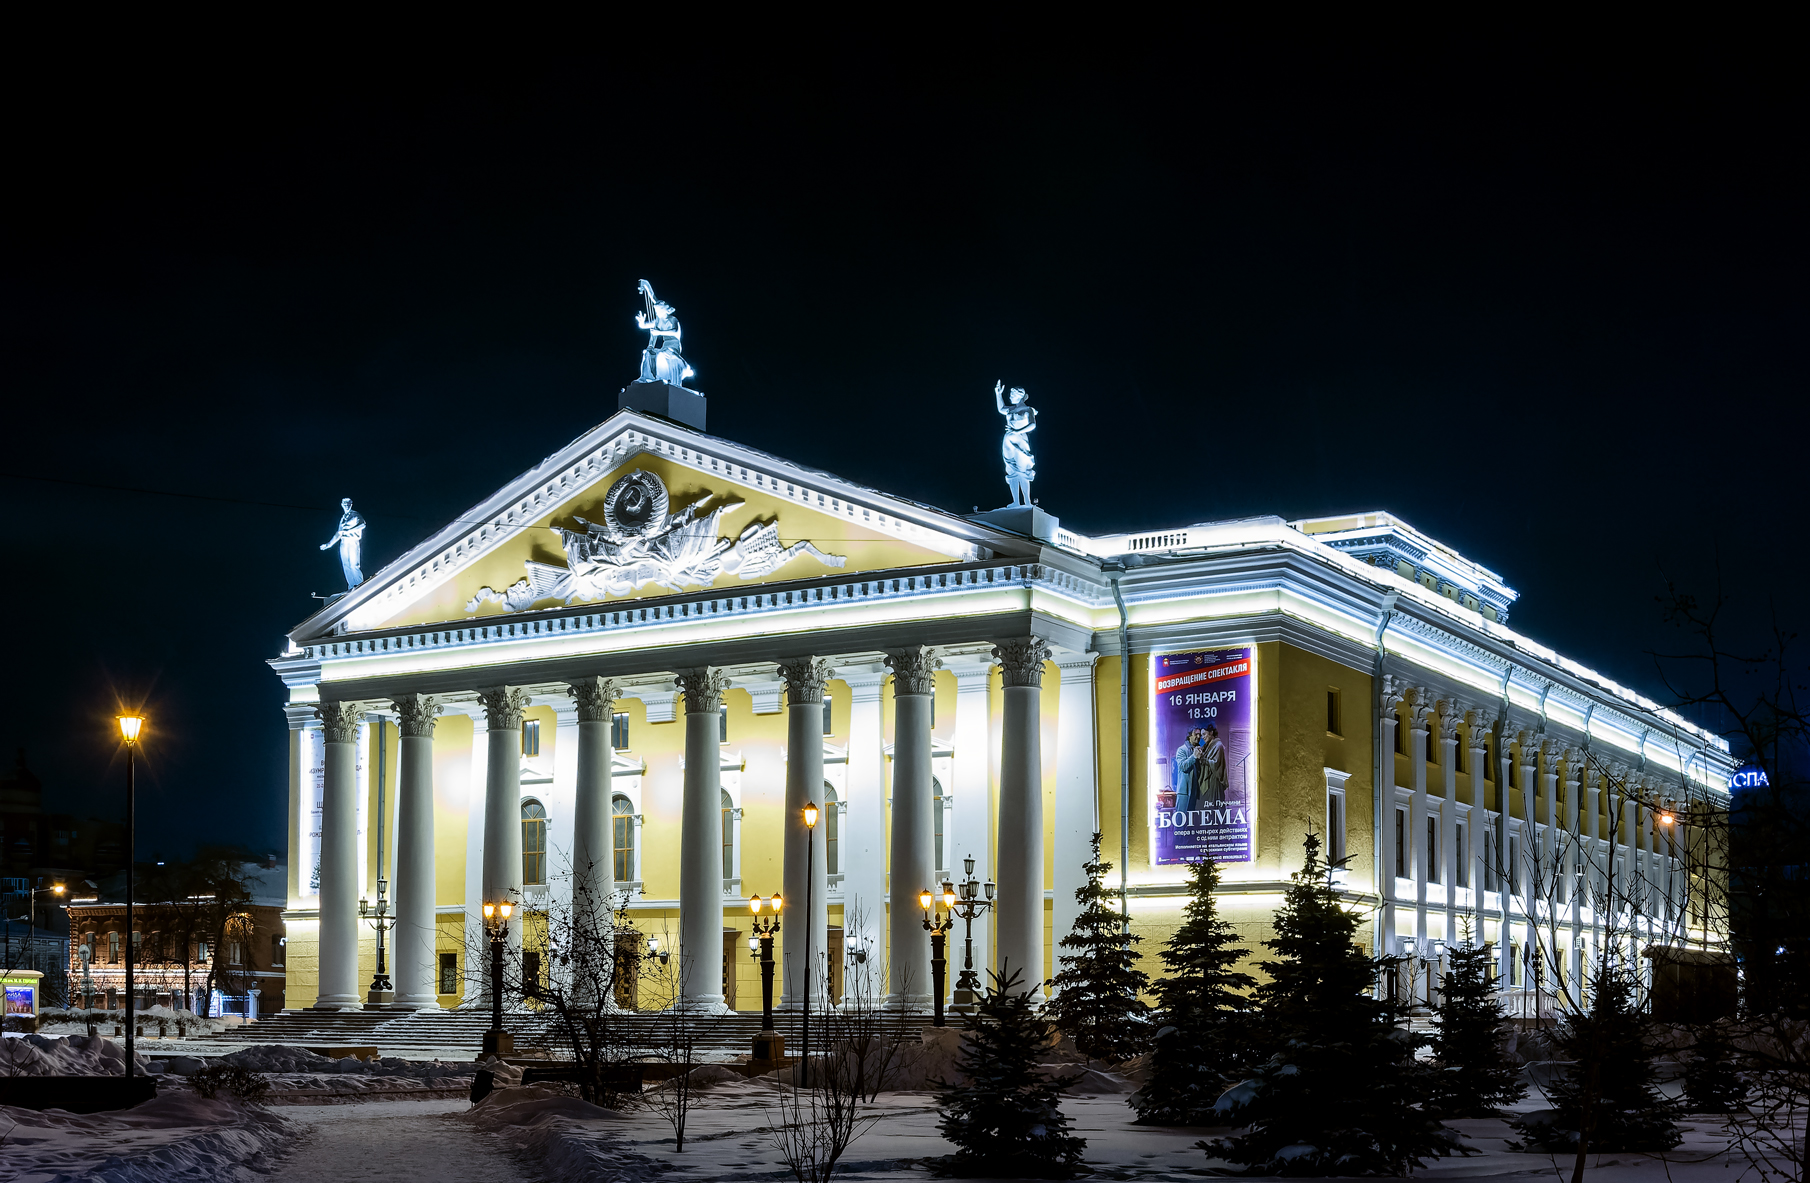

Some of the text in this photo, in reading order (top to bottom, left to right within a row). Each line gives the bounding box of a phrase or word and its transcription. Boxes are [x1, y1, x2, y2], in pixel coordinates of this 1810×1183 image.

[1158, 663, 1247, 690] ВОЗВРАЩЕНИЕ СПЕКТАКЛЯ
[1169, 690, 1236, 706] 16 ЯНВАРЯ
[1187, 706, 1218, 719] 18.30
[1158, 808, 1247, 828] БОГЕМА
[1219, 827, 1248, 835] действиях
